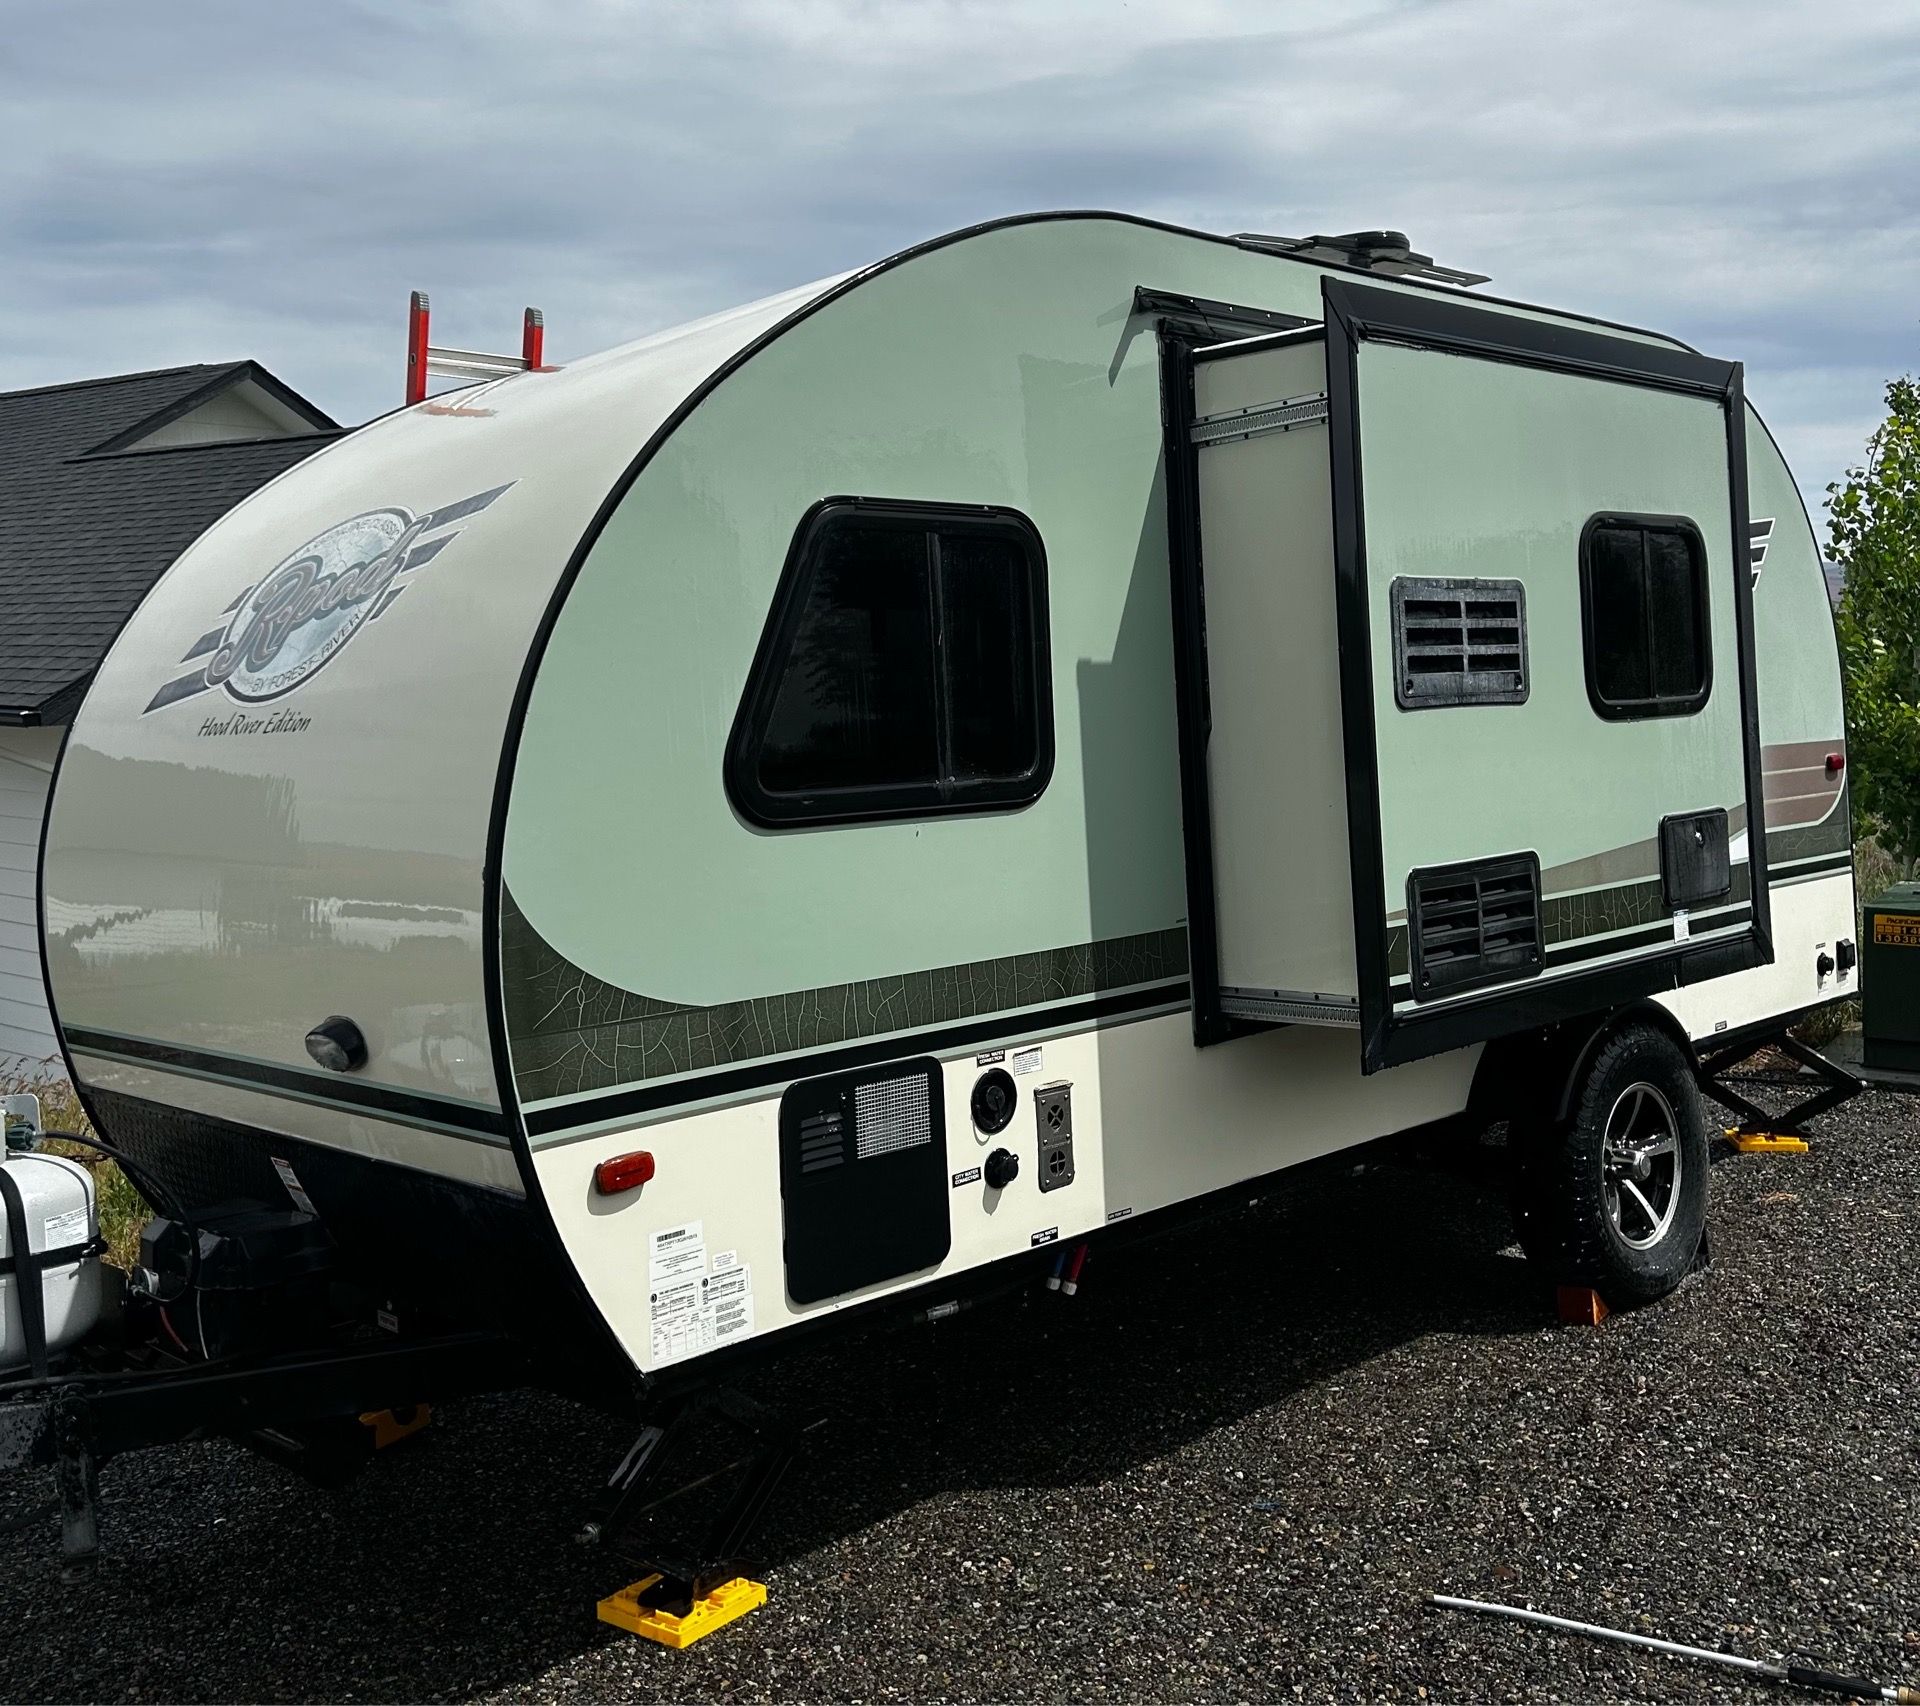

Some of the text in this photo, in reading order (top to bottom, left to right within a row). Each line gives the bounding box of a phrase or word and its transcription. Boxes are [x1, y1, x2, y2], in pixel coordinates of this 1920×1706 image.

[271, 655, 316, 687] FOREST
[198, 707, 311, 736] Hood River Edition
